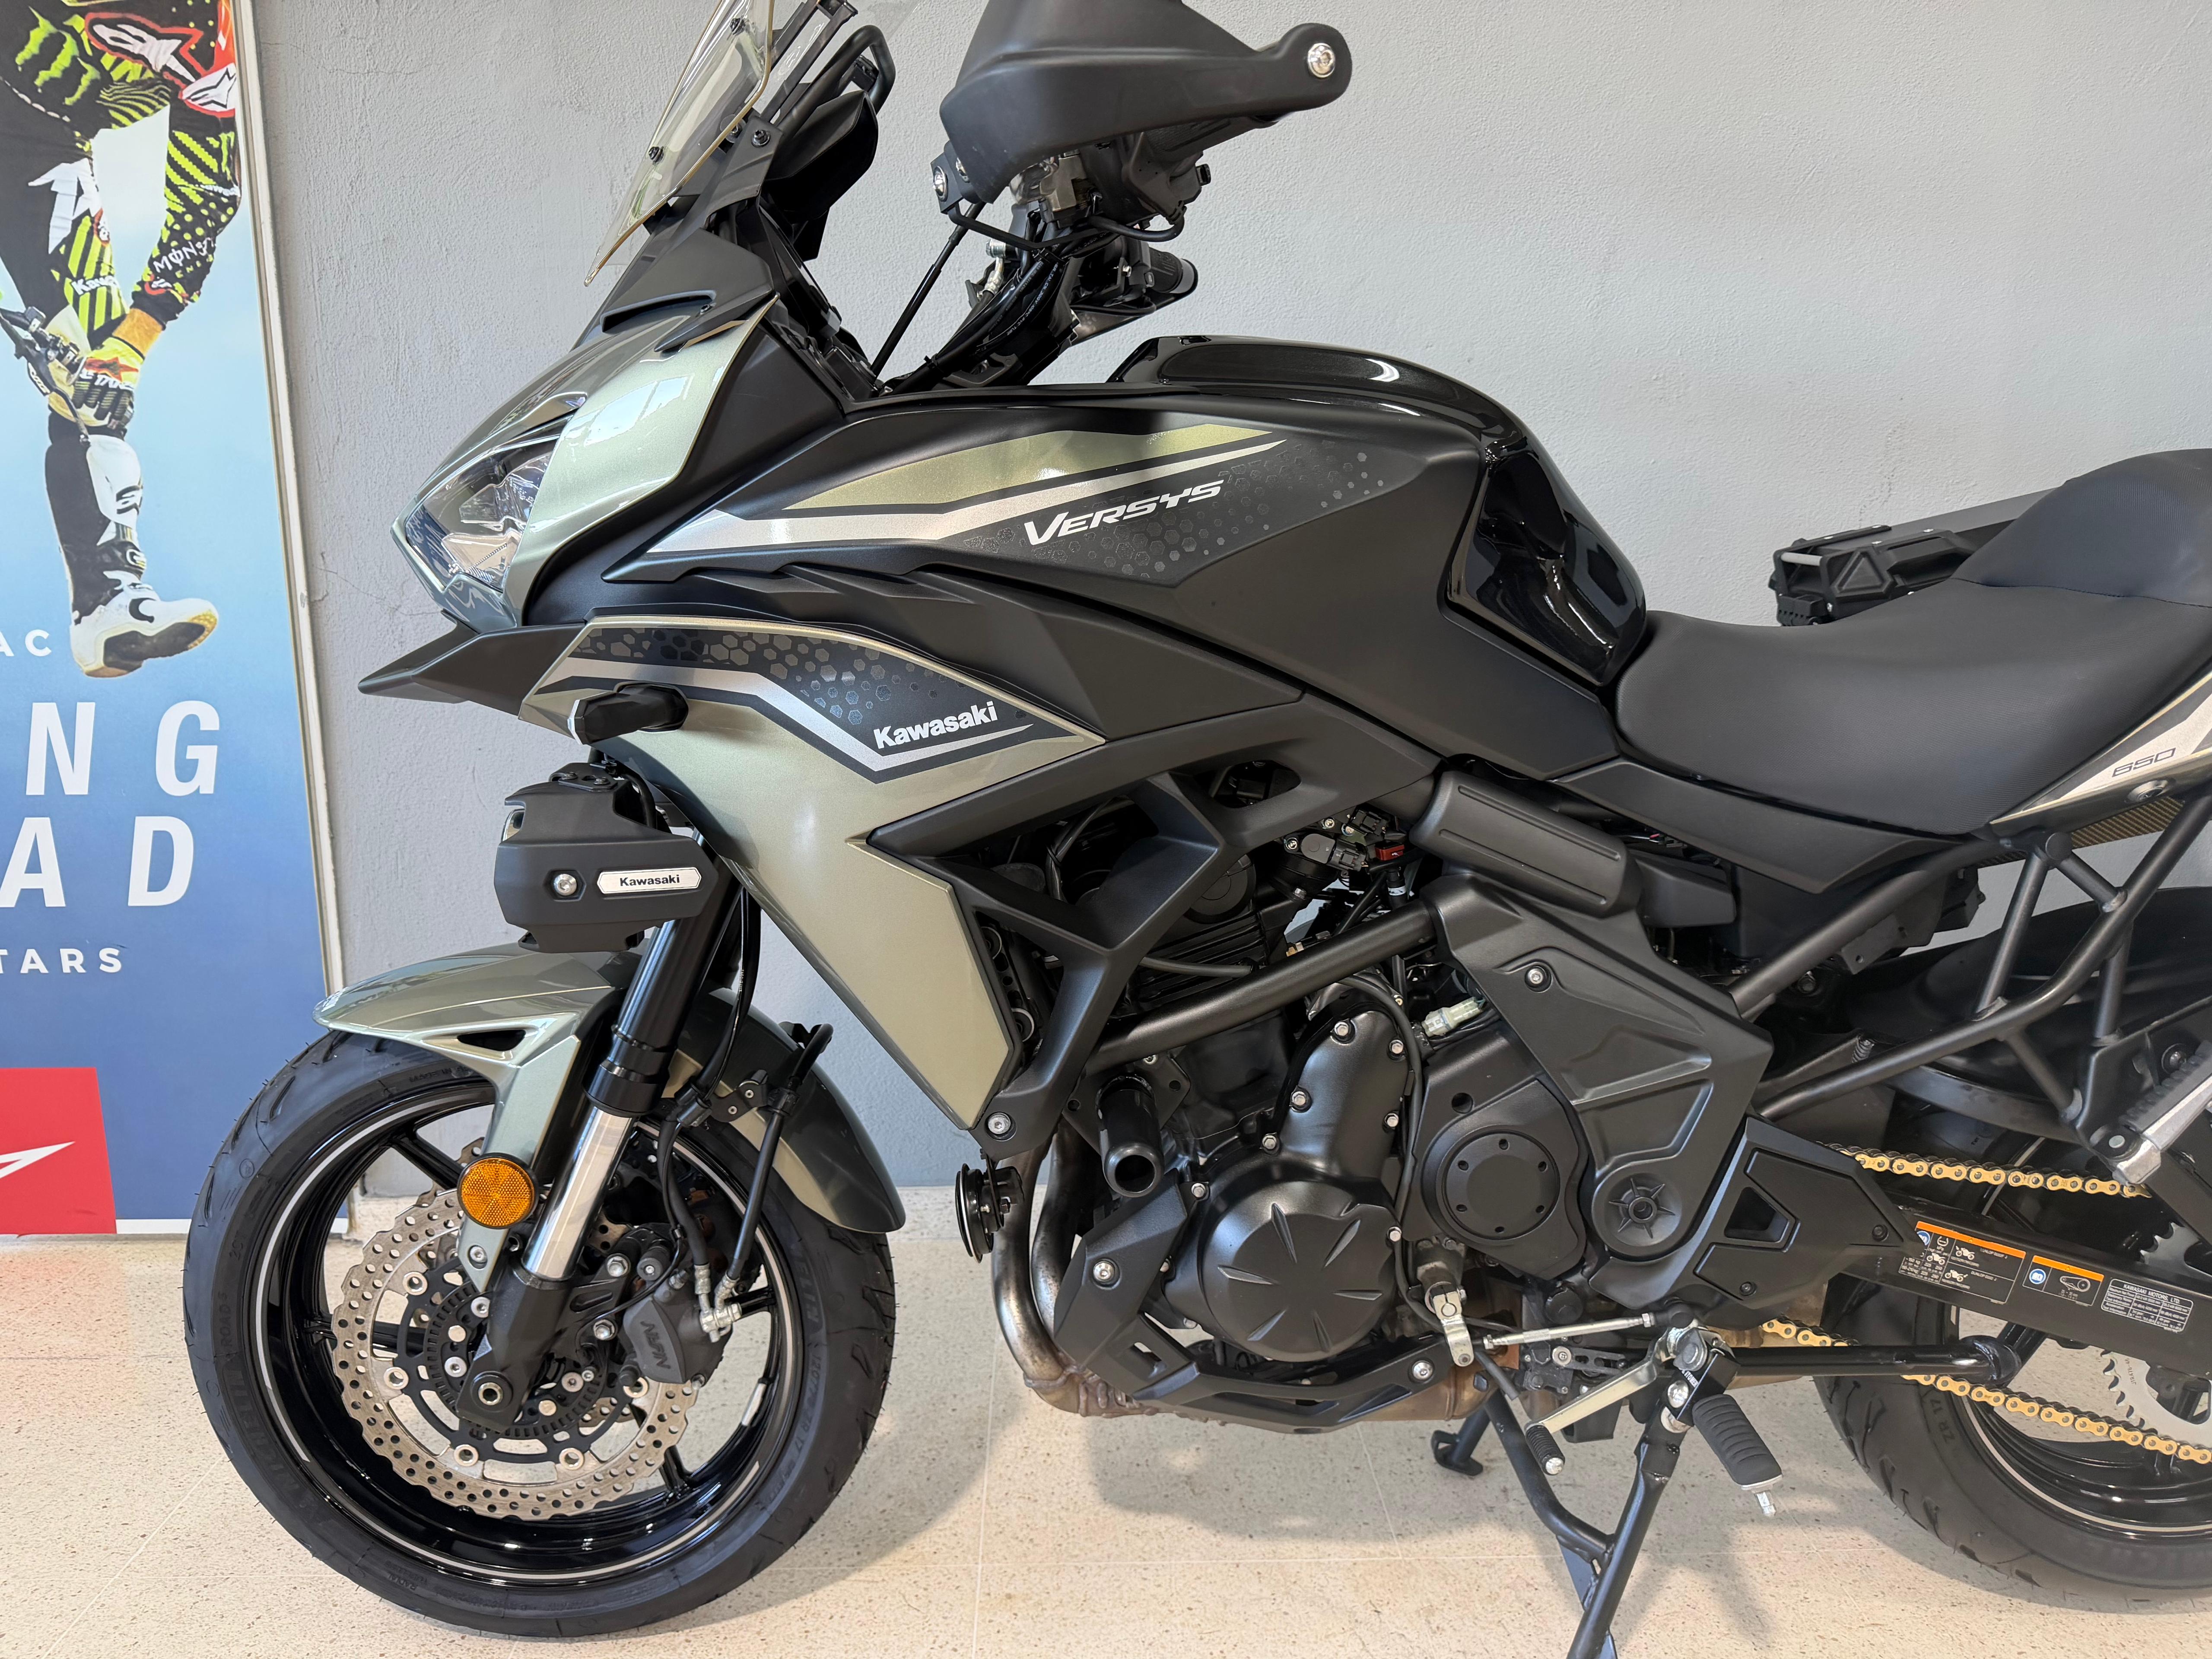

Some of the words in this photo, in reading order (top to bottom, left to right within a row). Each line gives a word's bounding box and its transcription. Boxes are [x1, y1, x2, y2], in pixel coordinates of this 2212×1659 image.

[1024, 480, 1224, 545] VERSYS
[25, 700, 219, 797] NG
[873, 701, 998, 749] Kawasaki
[2112, 747, 2176, 777] 650
[0, 816, 194, 907] AD
[620, 874, 680, 887] Kawasaki
[0, 948, 122, 974] ARS
